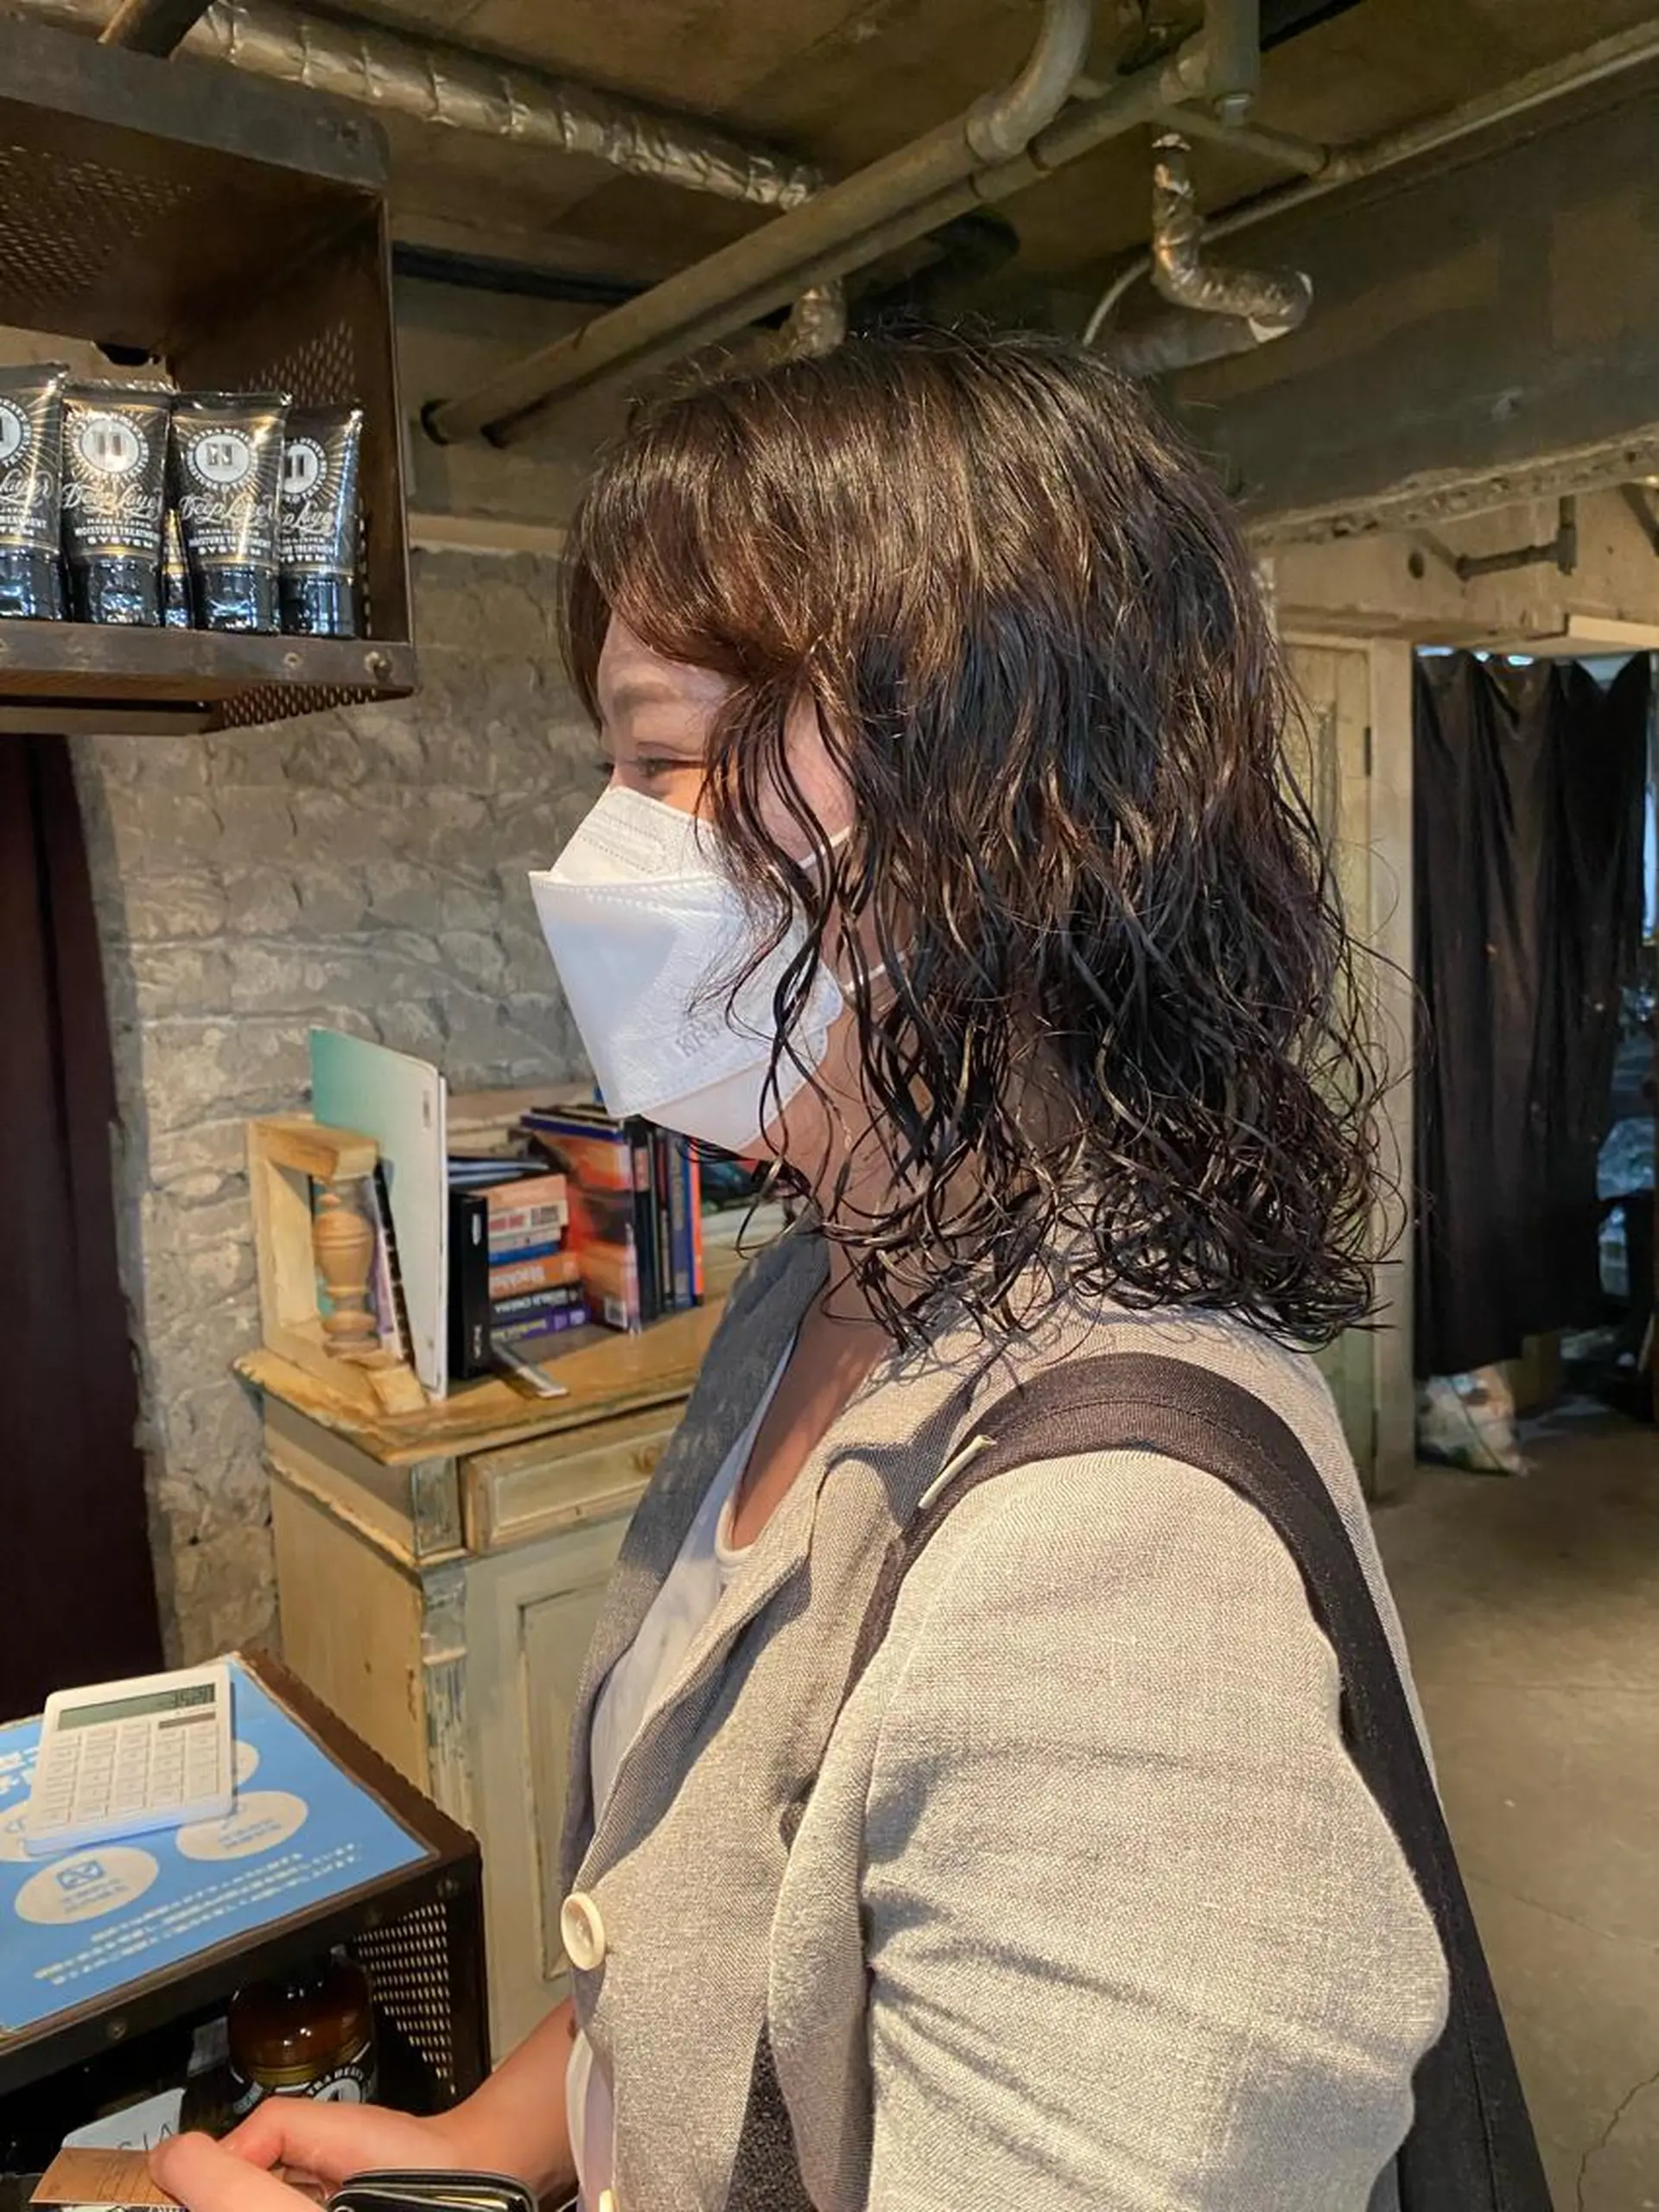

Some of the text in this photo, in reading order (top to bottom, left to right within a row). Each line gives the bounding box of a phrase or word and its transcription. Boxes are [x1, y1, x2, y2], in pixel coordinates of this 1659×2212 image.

[61, 481, 118, 515] Deep
[74, 526, 118, 537] MOISTURE
[87, 536, 153, 549] SYSTEM
